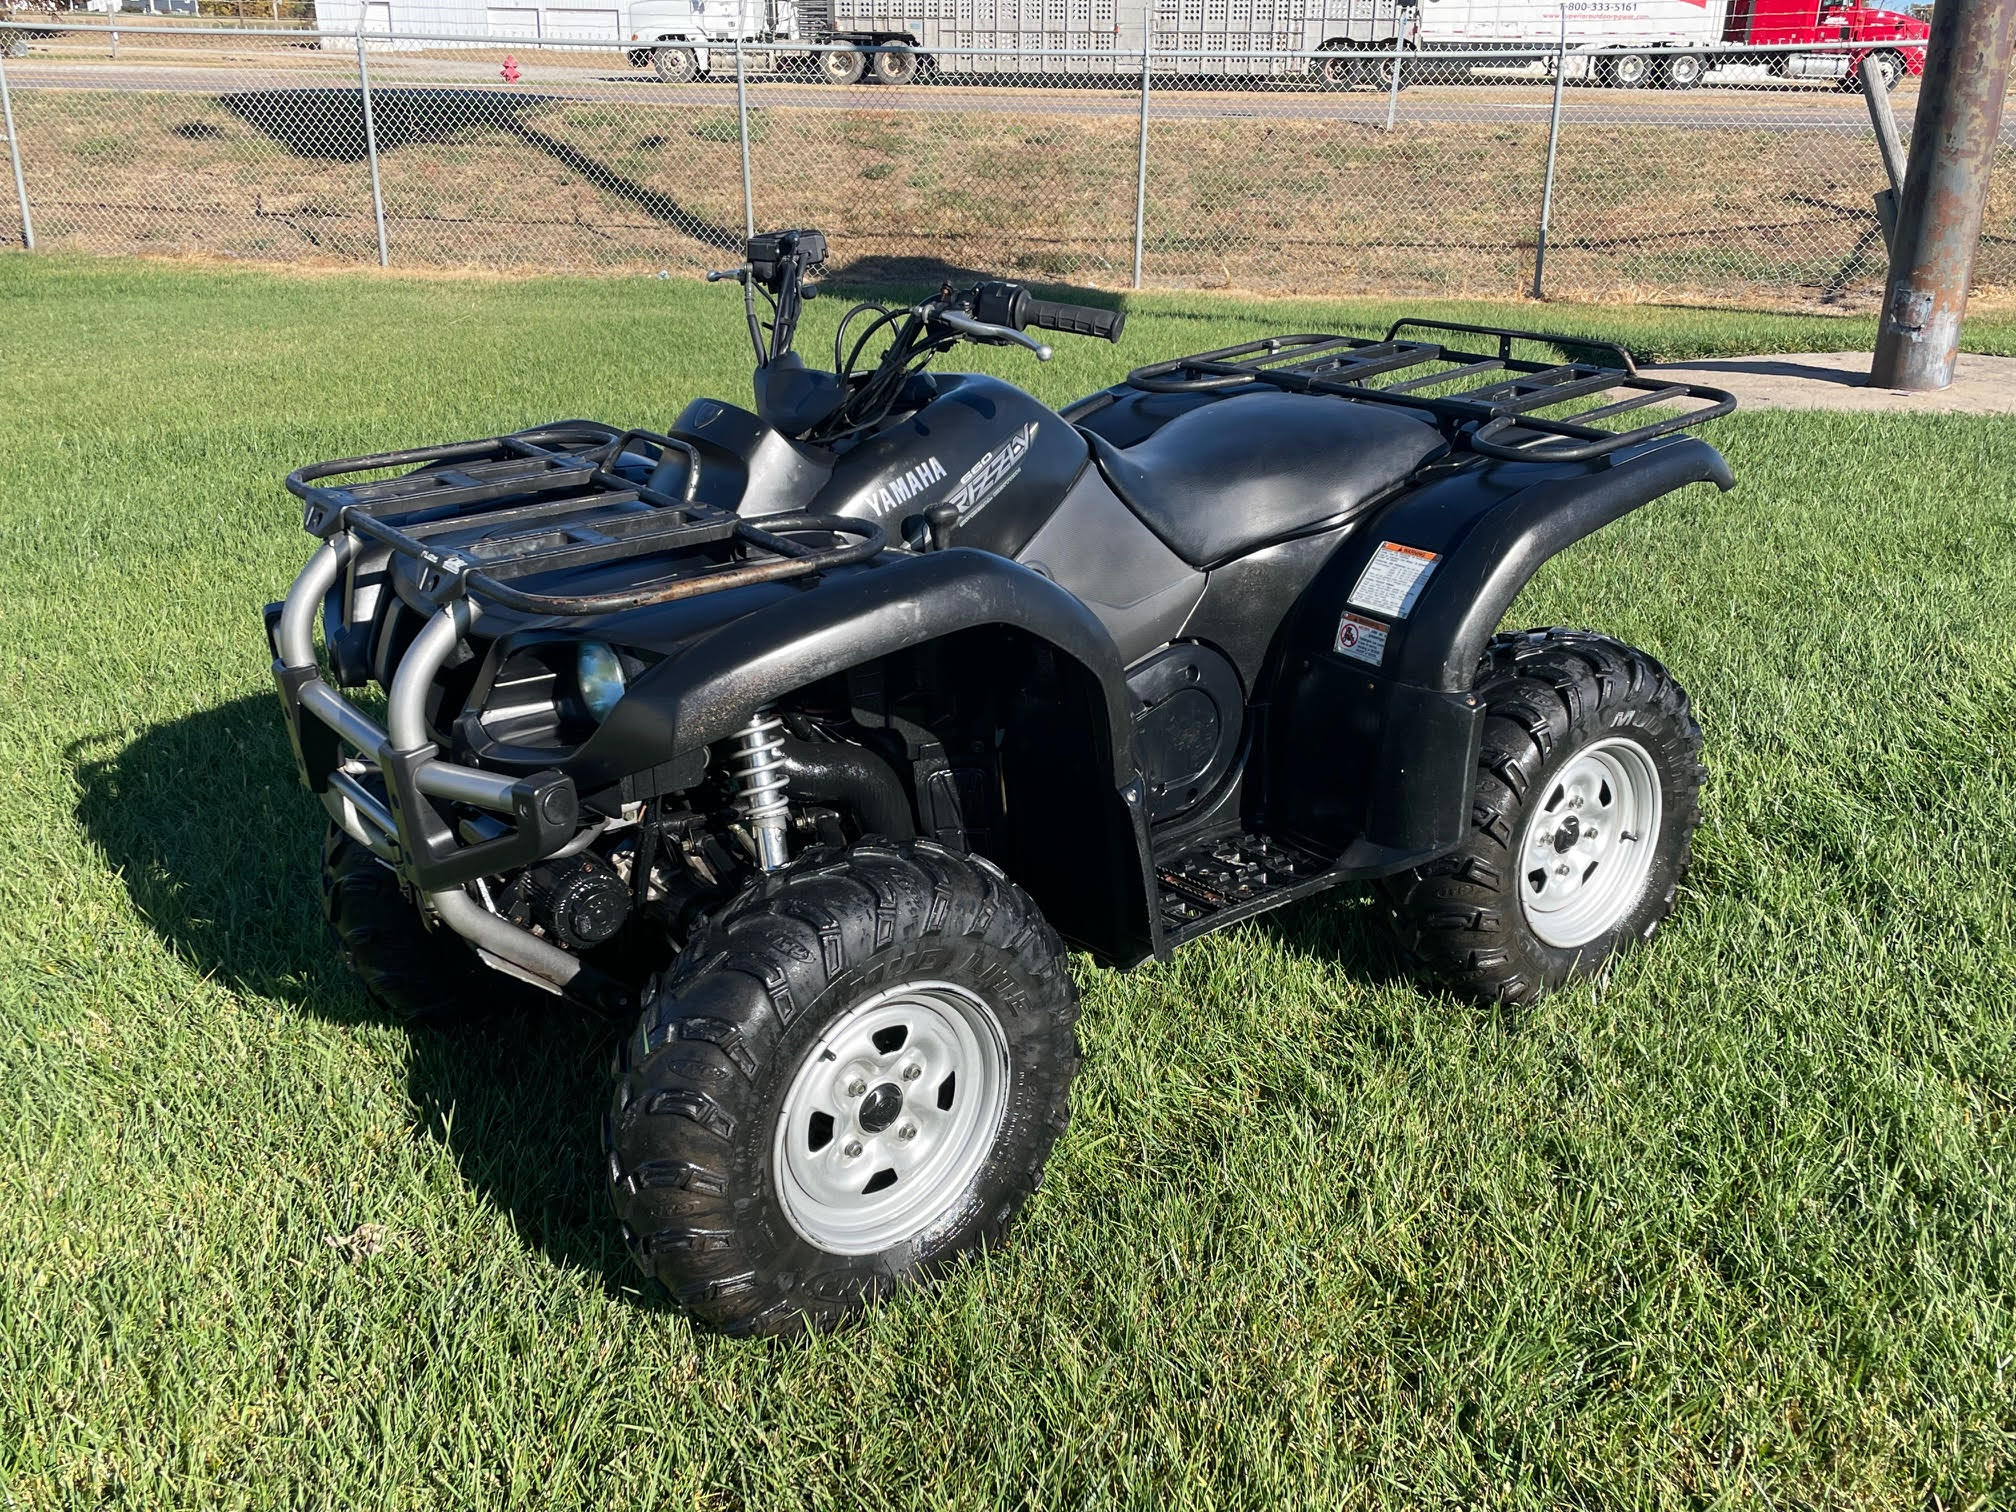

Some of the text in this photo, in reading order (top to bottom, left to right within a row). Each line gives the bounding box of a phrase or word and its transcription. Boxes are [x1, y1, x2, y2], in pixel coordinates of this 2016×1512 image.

[1560, 3, 1637, 11] 1-800-333-5161
[864, 456, 947, 517] YAMAHA
[948, 422, 1029, 513] RIZZLY
[960, 451, 993, 485] 660
